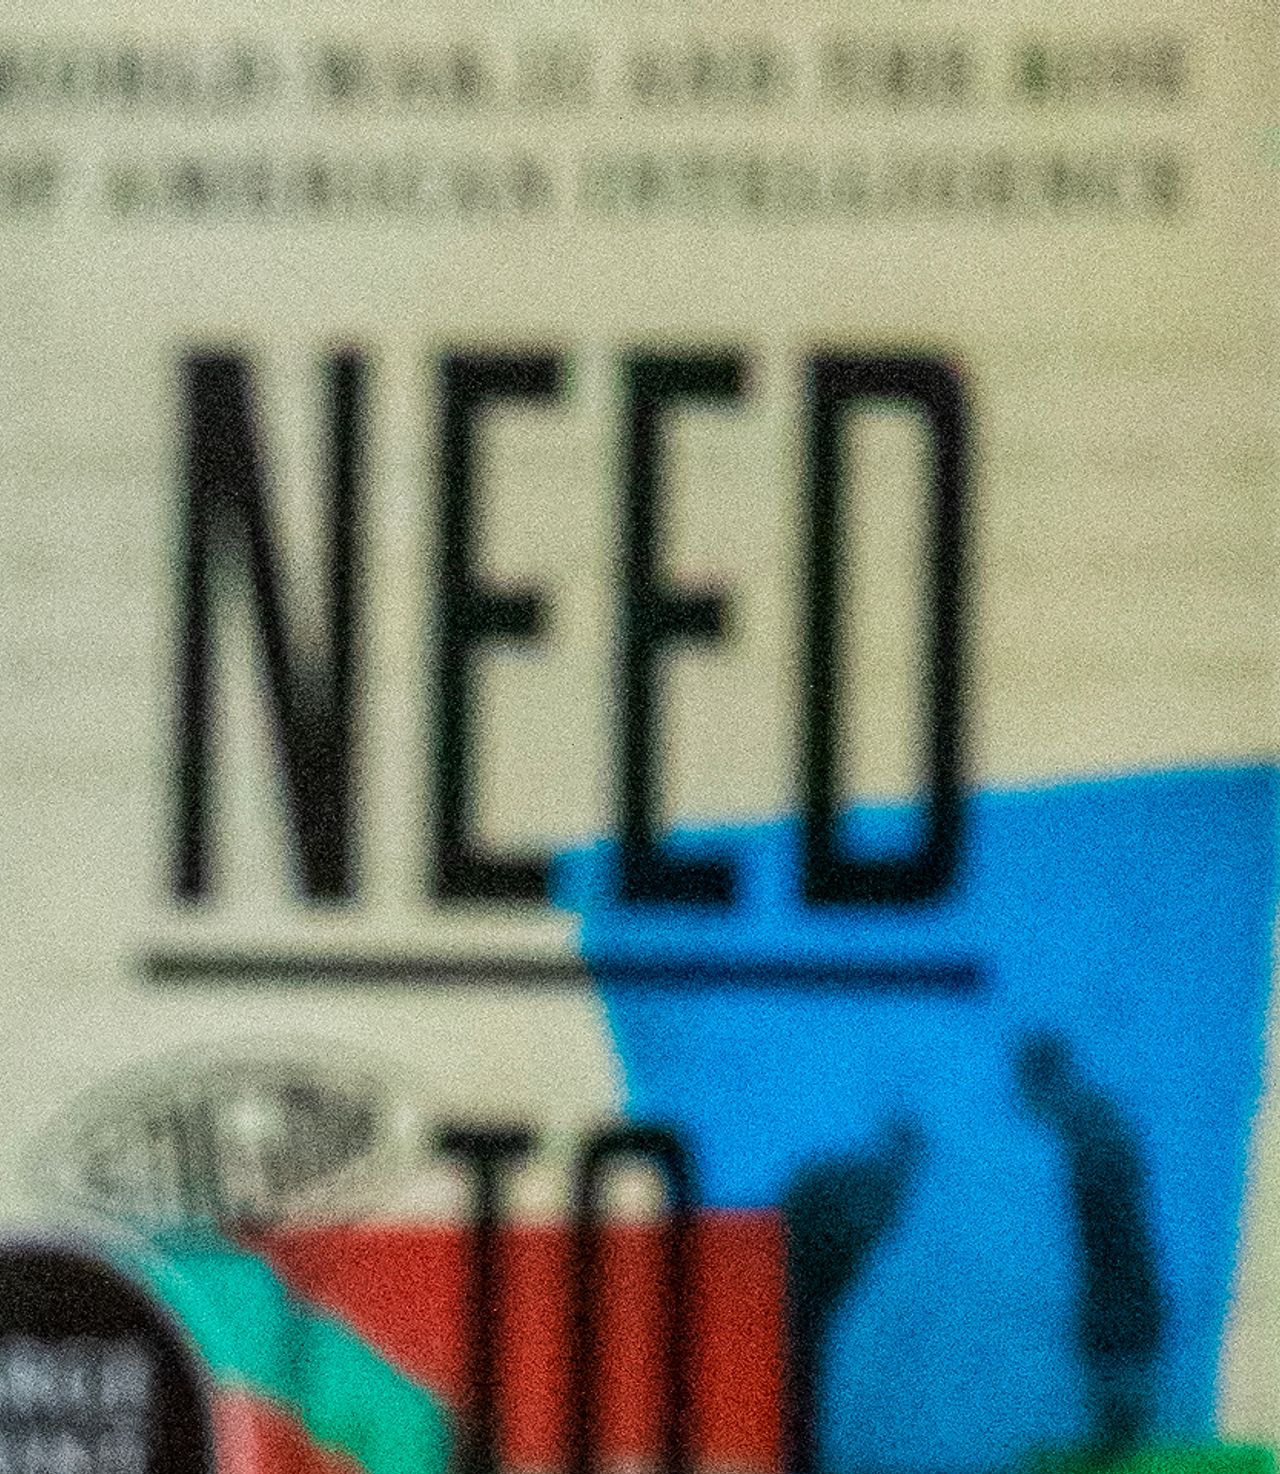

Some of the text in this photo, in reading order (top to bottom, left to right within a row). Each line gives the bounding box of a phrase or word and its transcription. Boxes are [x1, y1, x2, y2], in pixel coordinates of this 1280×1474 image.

[310, 38, 490, 107] WAR
[618, 40, 786, 108] AND
[822, 40, 980, 109] THE
[1010, 41, 1192, 110] RISE
[96, 148, 552, 217] AMERICAN
[584, 149, 1190, 219] INTELLIGENCE
[172, 346, 976, 908] NEED
